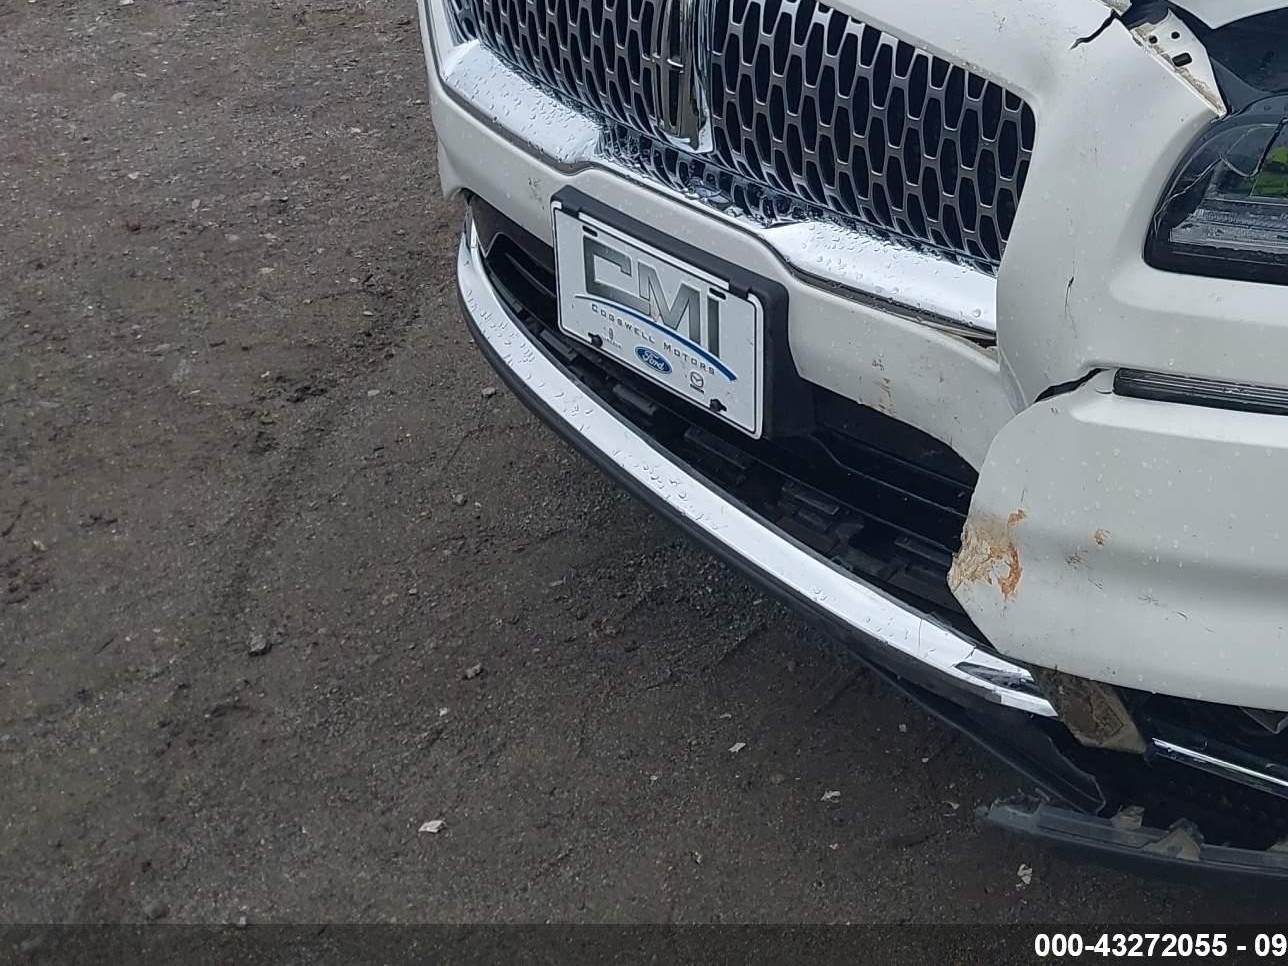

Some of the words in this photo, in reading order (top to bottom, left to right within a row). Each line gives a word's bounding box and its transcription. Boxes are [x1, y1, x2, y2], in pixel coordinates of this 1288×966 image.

[582, 234, 720, 359] CMI
[591, 303, 655, 345] COGSWELL
[663, 341, 716, 376] MOTORS
[641, 349, 666, 372] Ford
